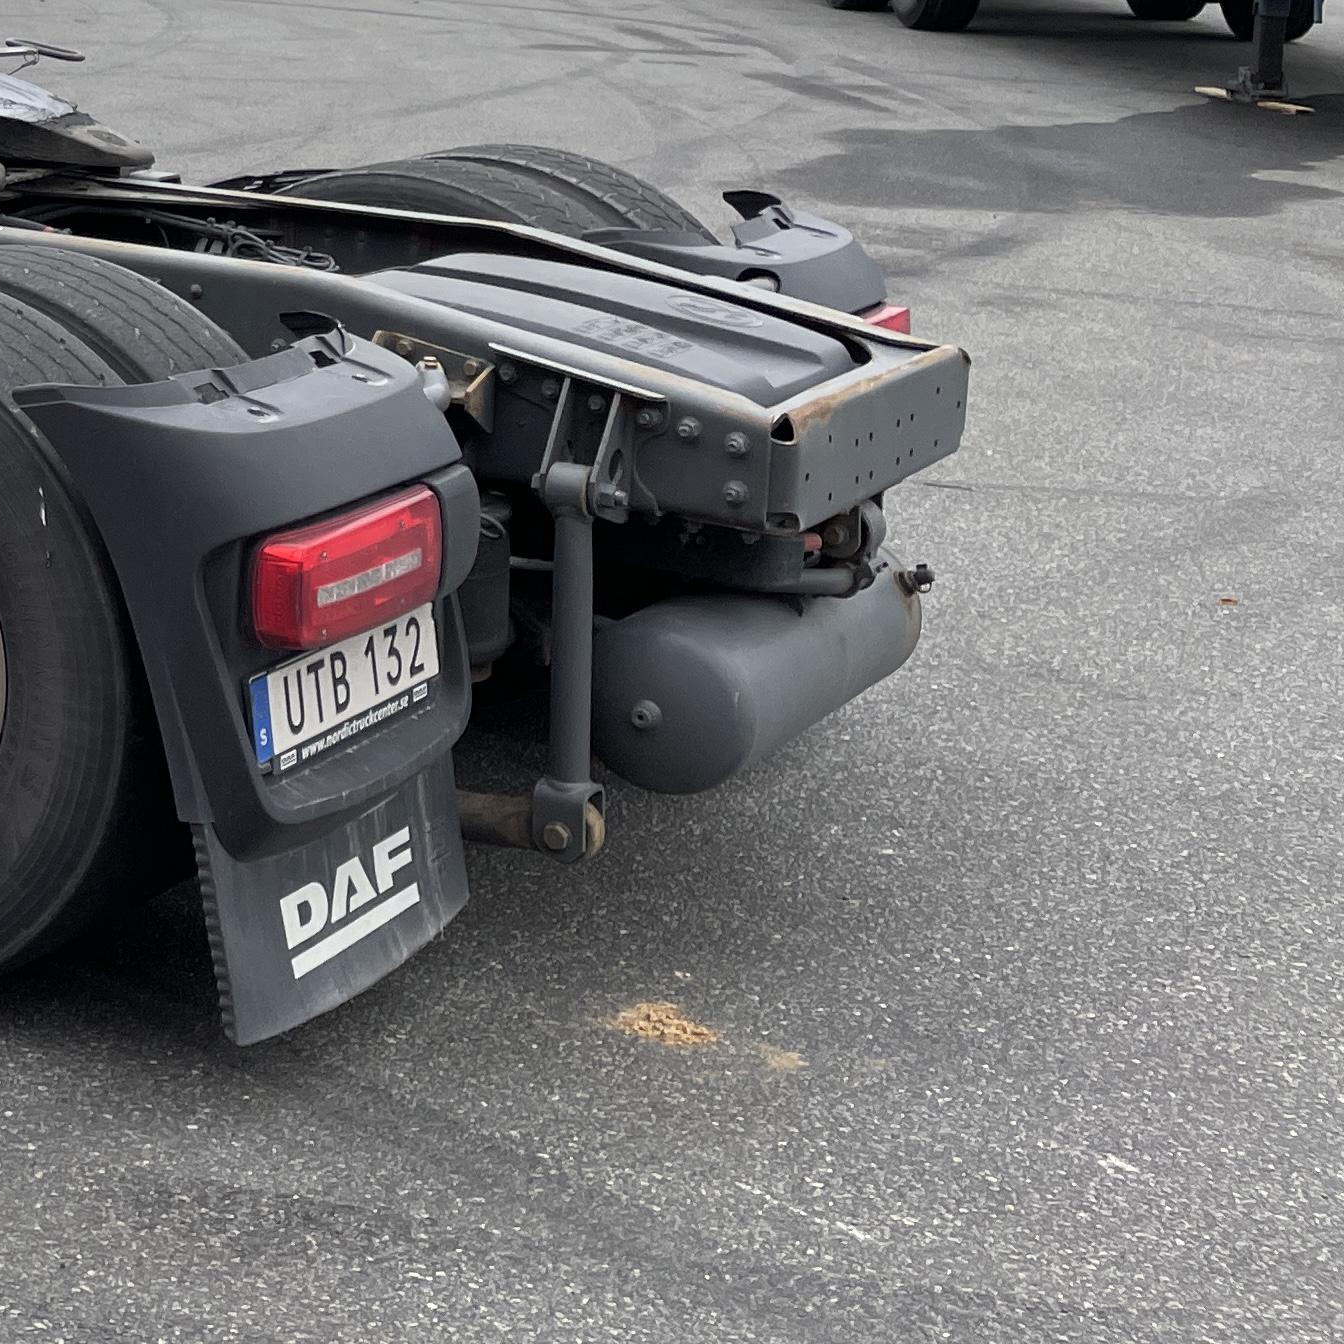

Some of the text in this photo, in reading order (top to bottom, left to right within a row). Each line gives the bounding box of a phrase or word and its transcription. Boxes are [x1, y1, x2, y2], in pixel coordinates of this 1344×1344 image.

[283, 616, 425, 736] UTB 132
[259, 728, 268, 746] S
[301, 695, 410, 760] www.nordictruckcenter.se
[279, 825, 413, 950] DAF
